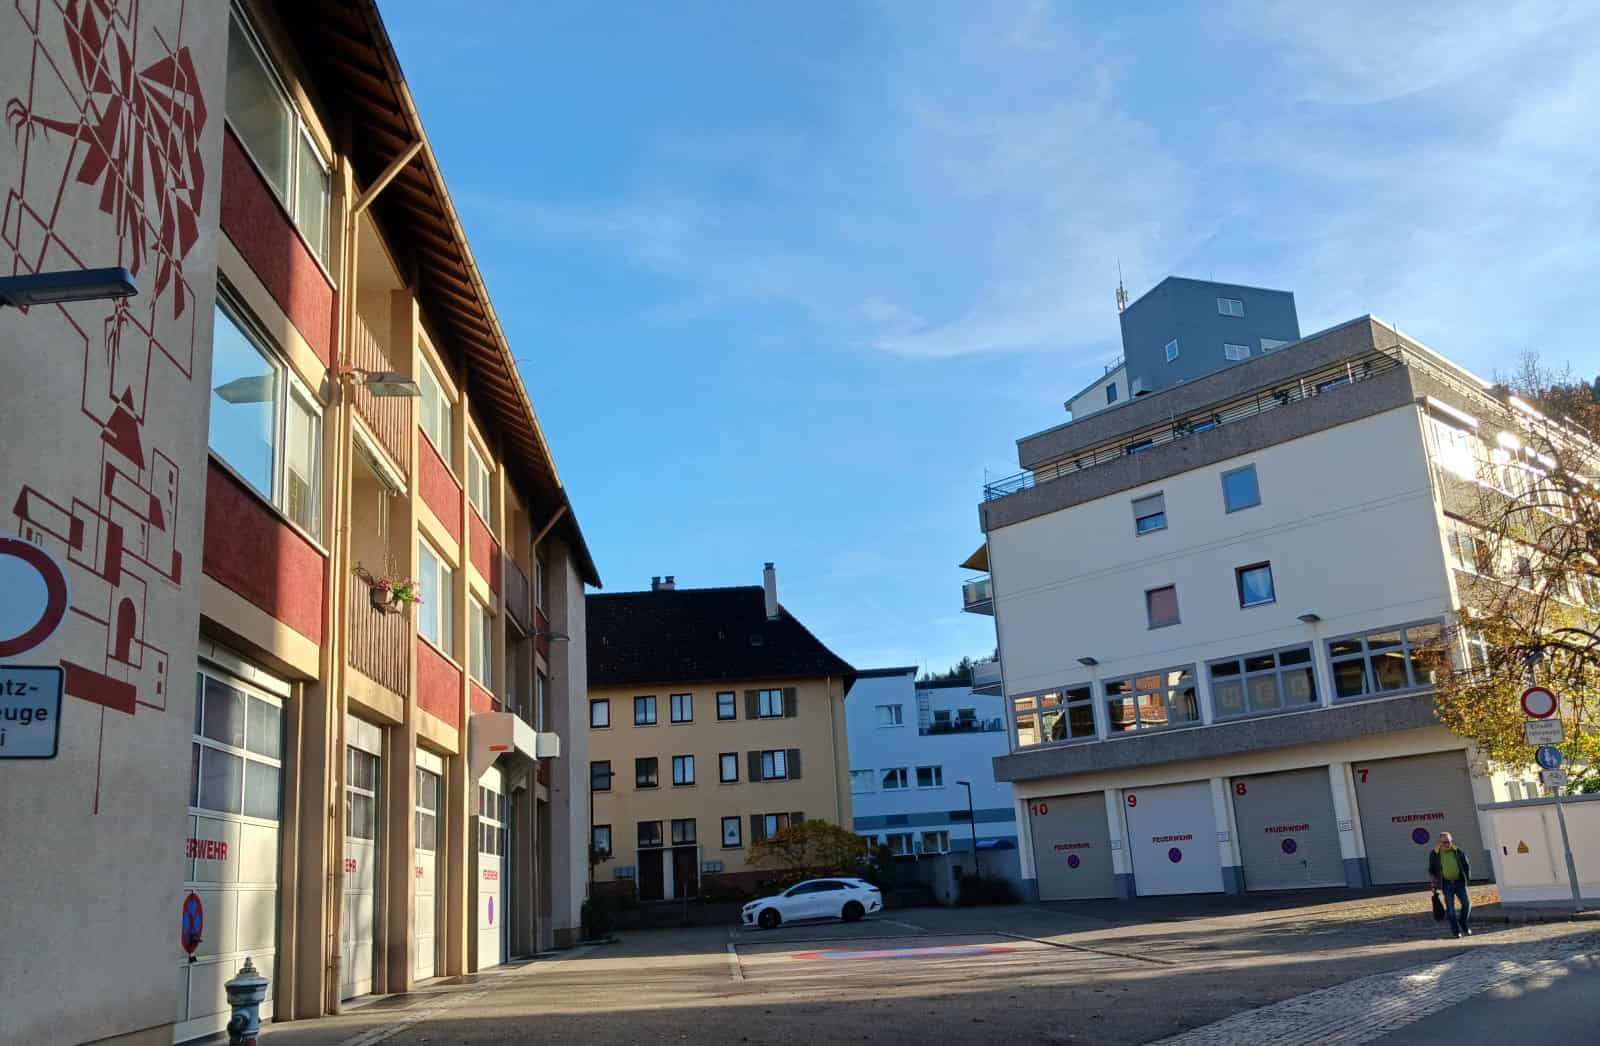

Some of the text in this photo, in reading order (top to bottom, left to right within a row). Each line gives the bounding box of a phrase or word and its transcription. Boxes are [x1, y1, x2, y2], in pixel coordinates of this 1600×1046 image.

[1357, 768, 1369, 784] 7
[1235, 782, 1247, 796] 8
[1127, 794, 1137, 808] 9
[1031, 803, 1048, 817] 10
[1391, 812, 1445, 823] FEUERWEHR
[1152, 833, 1193, 844] FEUERWEHR
